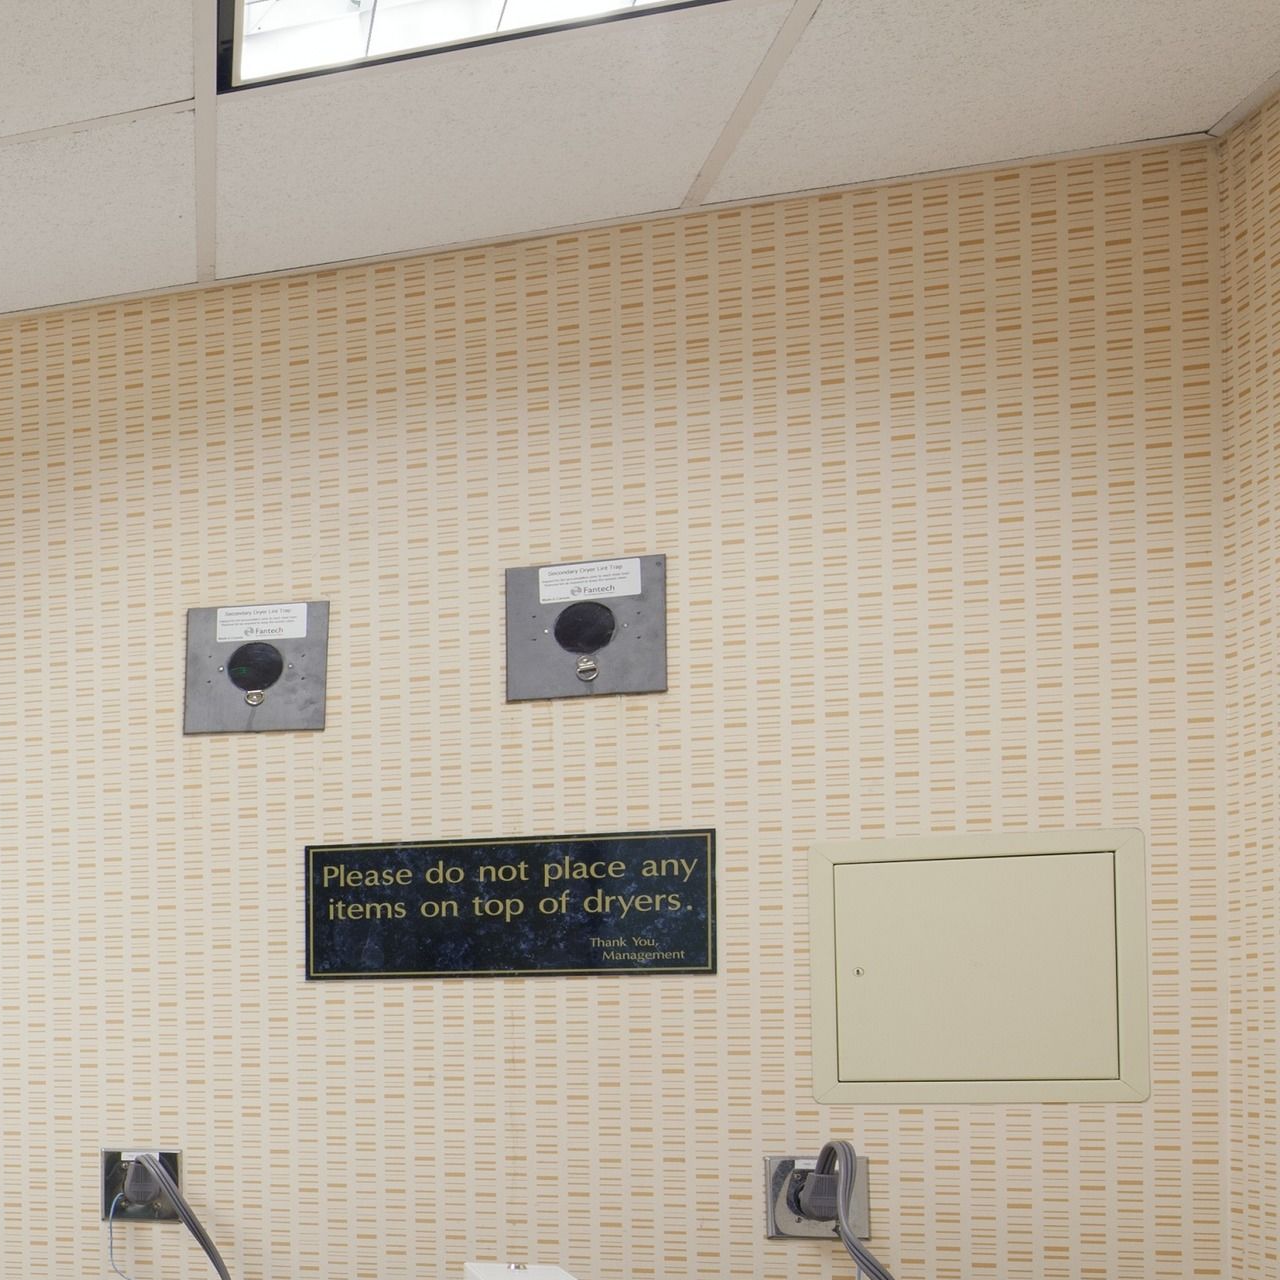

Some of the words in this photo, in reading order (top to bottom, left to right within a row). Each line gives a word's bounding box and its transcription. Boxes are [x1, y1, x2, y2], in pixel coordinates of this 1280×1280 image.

[584, 585, 615, 593] Fantech
[322, 864, 412, 888] Please
[425, 861, 465, 884] do
[479, 860, 529, 883] not
[544, 855, 625, 887] place
[641, 857, 698, 882] any
[328, 898, 406, 920] items
[420, 900, 458, 918] on
[473, 894, 525, 922] top
[539, 889, 571, 915] of
[583, 888, 694, 919] dryers.
[590, 937, 627, 947] Thank
[632, 936, 659, 948] You,
[602, 950, 685, 962] Management
